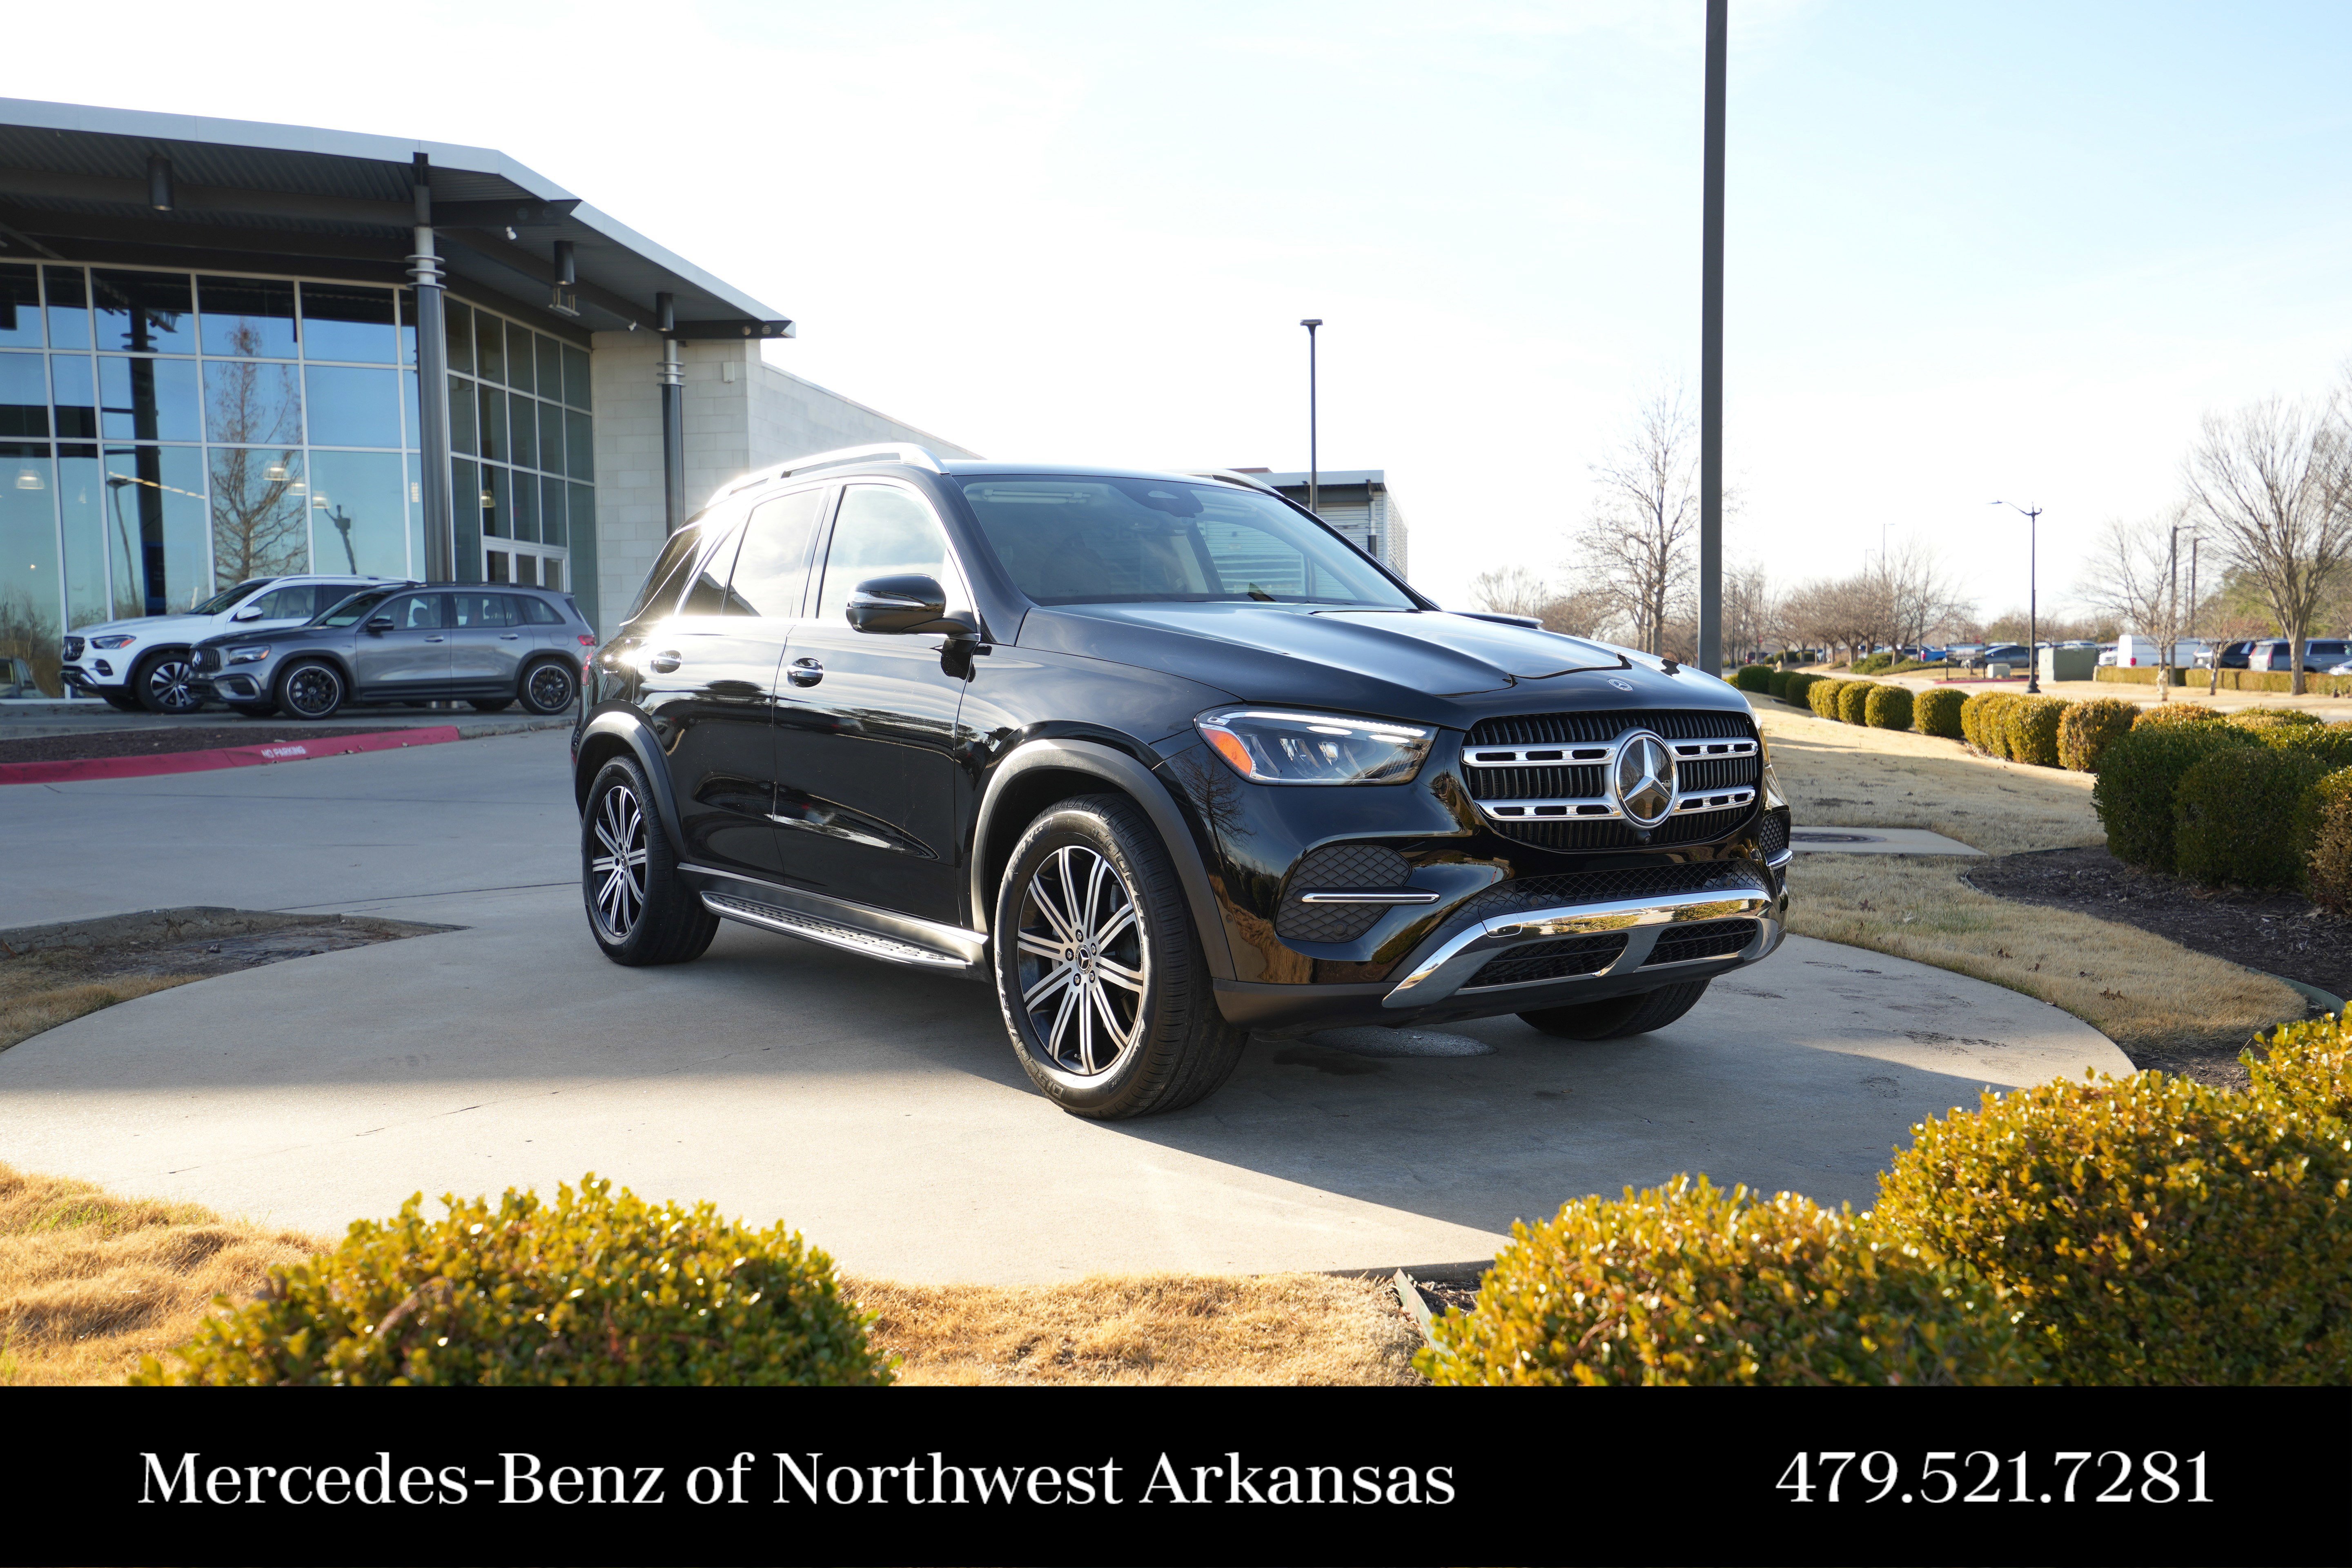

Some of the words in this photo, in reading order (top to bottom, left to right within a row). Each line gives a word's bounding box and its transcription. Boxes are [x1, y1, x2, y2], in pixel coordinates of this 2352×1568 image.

[261, 748, 274, 759] NO
[272, 746, 306, 757] PARKING
[1094, 827, 1152, 938] COOPER
[996, 950, 1065, 1100] DISCOVERER
